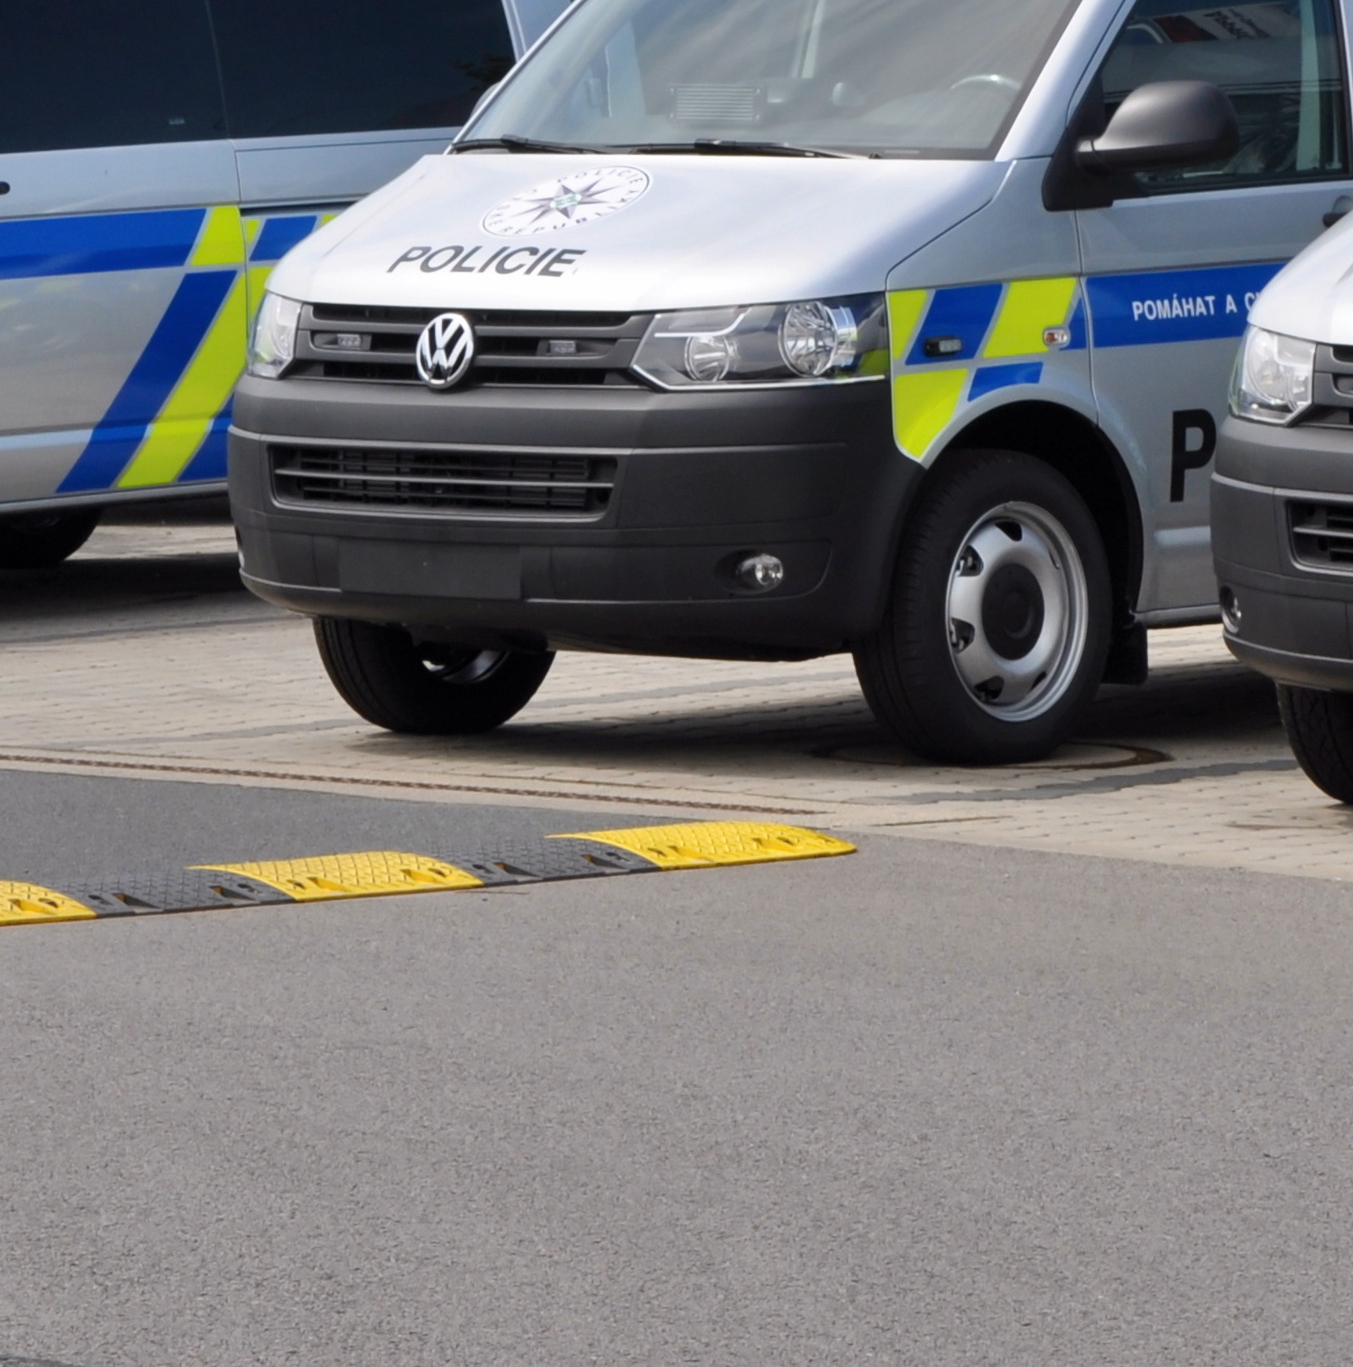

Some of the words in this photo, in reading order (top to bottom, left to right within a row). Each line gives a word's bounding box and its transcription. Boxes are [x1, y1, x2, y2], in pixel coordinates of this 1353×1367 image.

[386, 245, 587, 277] POLICIE
[1131, 293, 1216, 321] POMÁHAT
[1225, 294, 1238, 314] A
